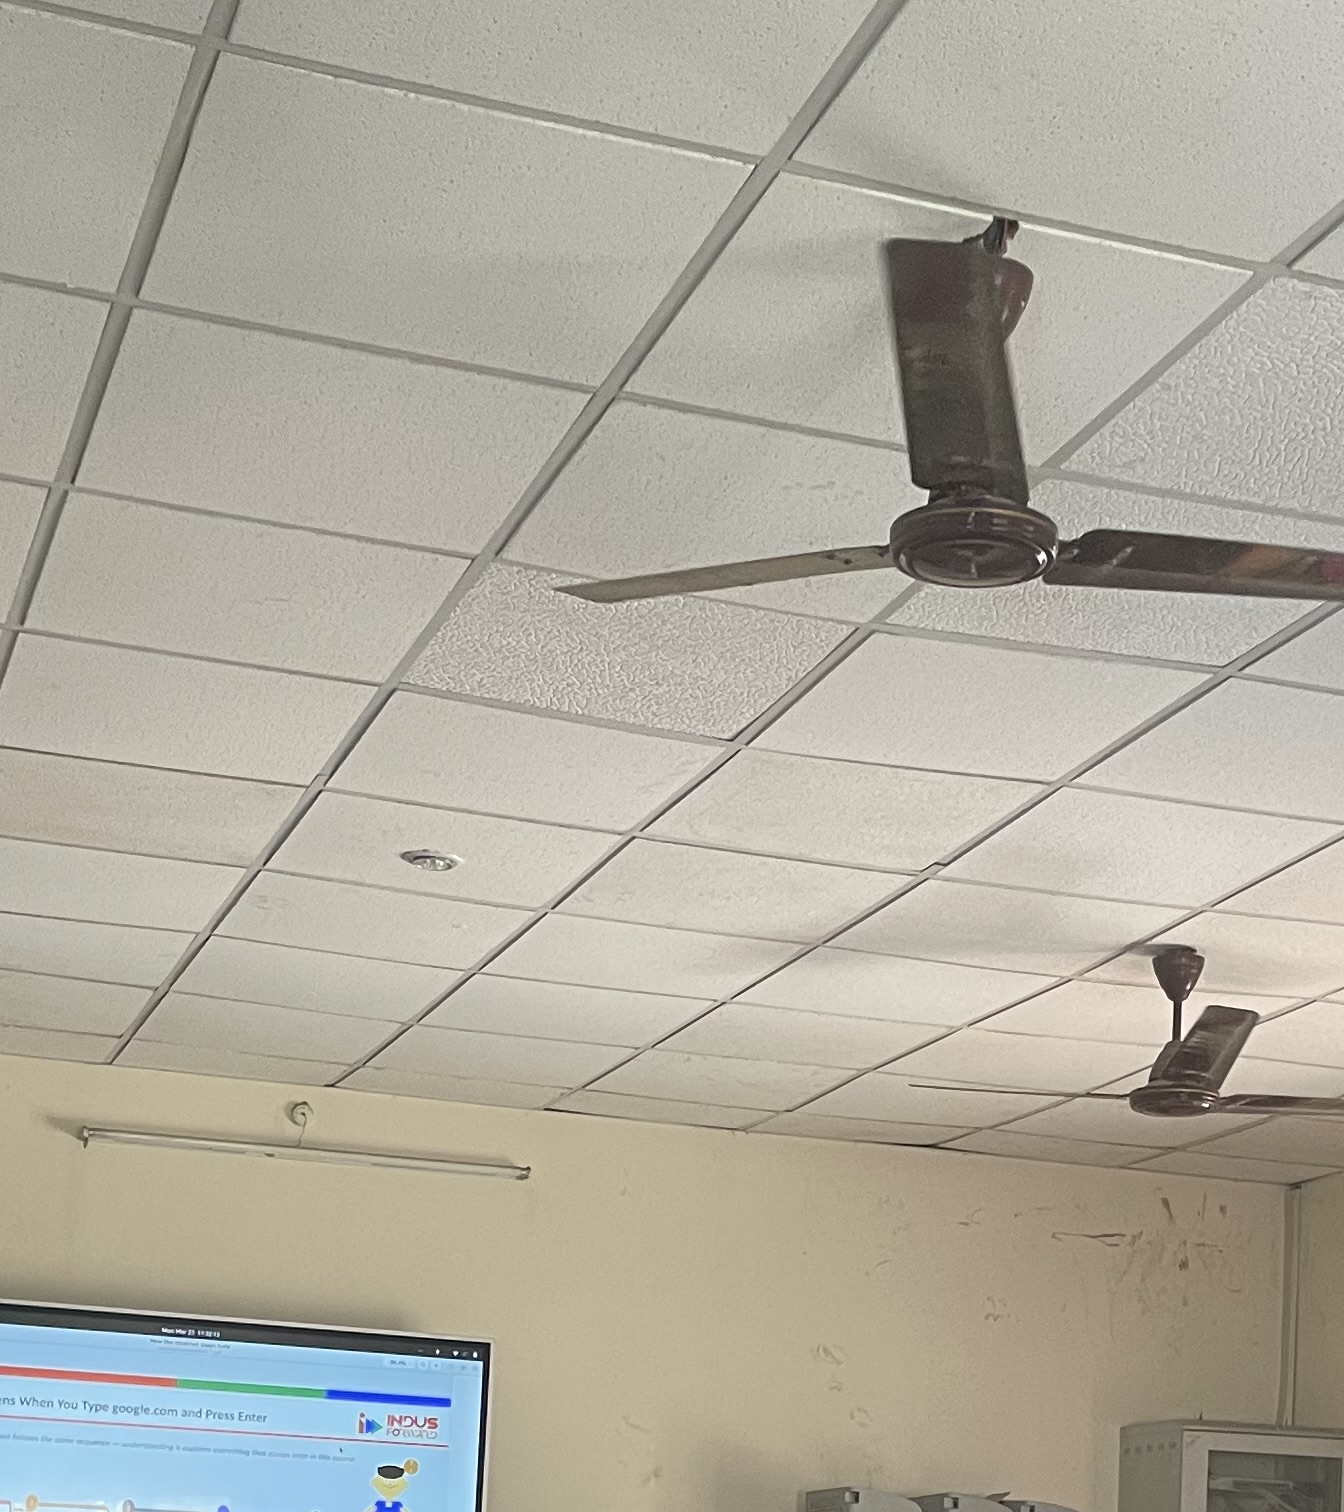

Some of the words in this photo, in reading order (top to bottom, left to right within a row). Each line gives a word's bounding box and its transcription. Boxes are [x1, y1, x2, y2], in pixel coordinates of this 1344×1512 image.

[19, 1396, 54, 1408] When
[57, 1399, 78, 1410] You
[82, 1400, 109, 1414] Type
[112, 1403, 178, 1417] google.com
[181, 1407, 203, 1418] and
[205, 1409, 235, 1421] Press
[238, 1411, 268, 1423] Enter
[387, 1414, 439, 1429] INDUS
